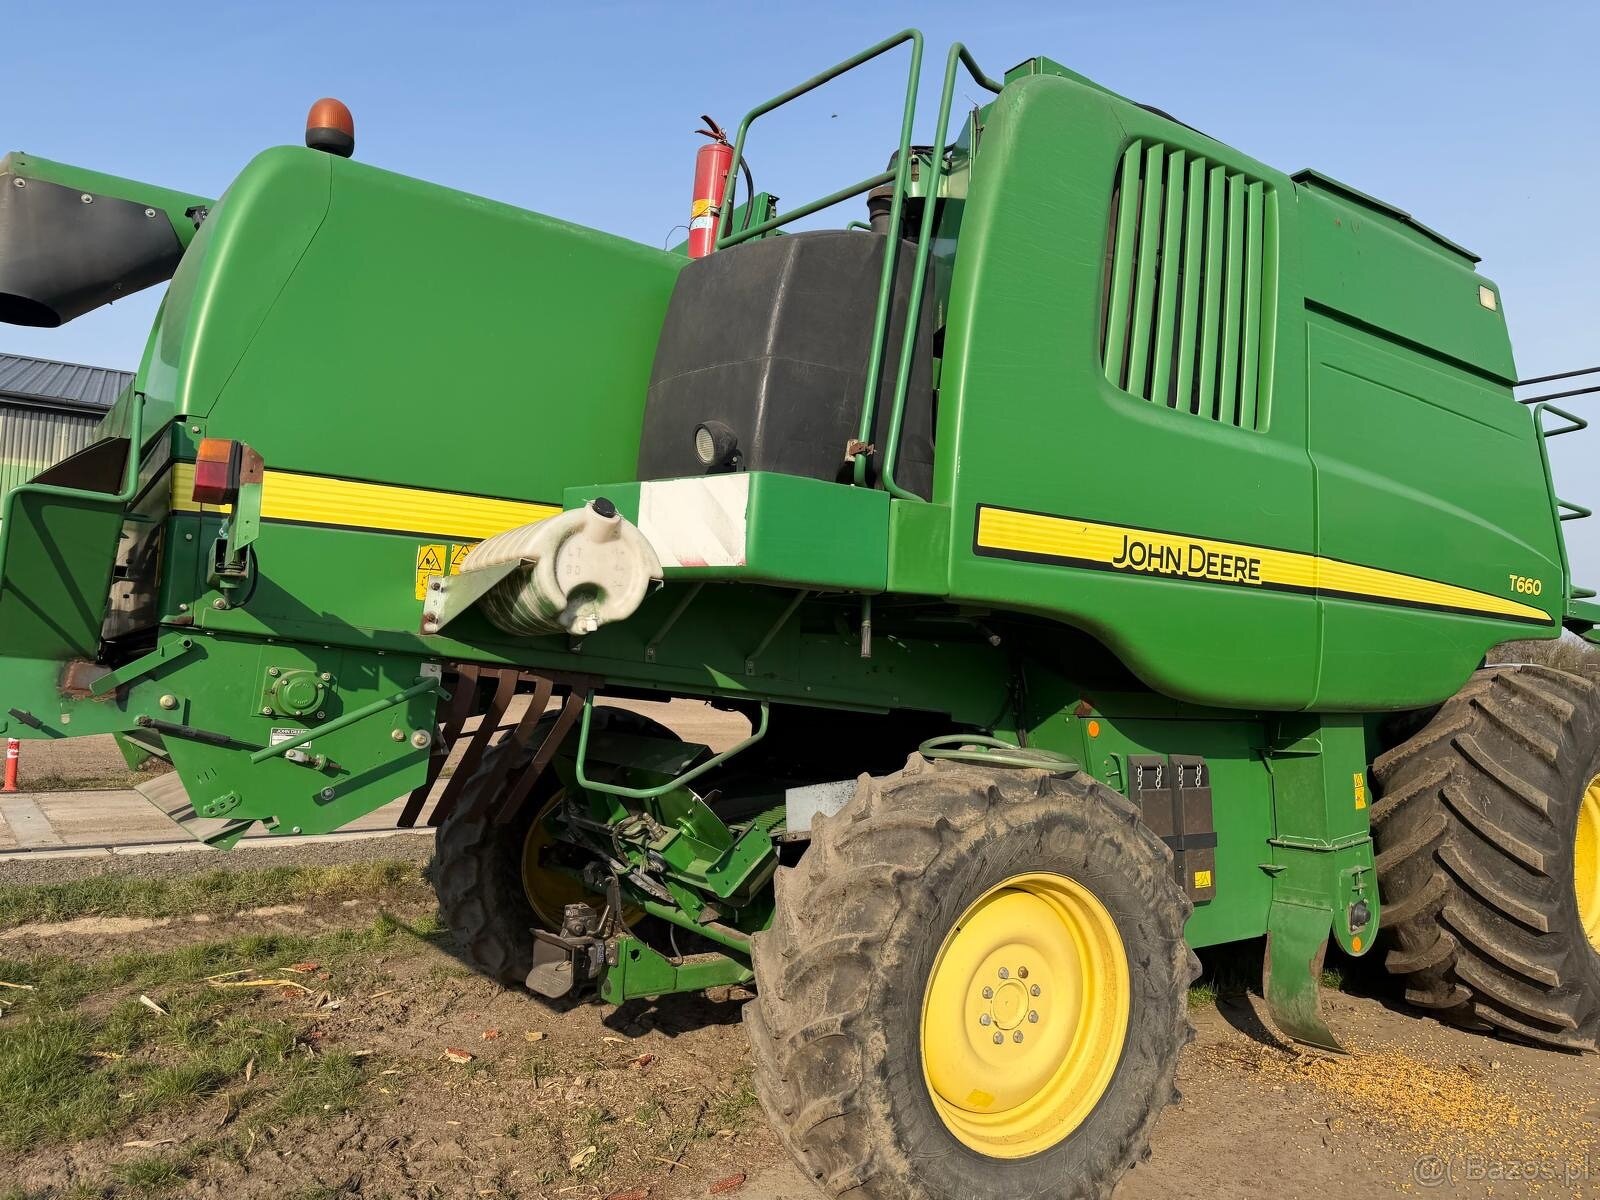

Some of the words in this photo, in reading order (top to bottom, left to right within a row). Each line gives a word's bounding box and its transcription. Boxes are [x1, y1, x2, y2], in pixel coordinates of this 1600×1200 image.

[1112, 534, 1182, 571] JOHN
[1188, 544, 1261, 581] DEERE
[1509, 574, 1542, 596] T660
